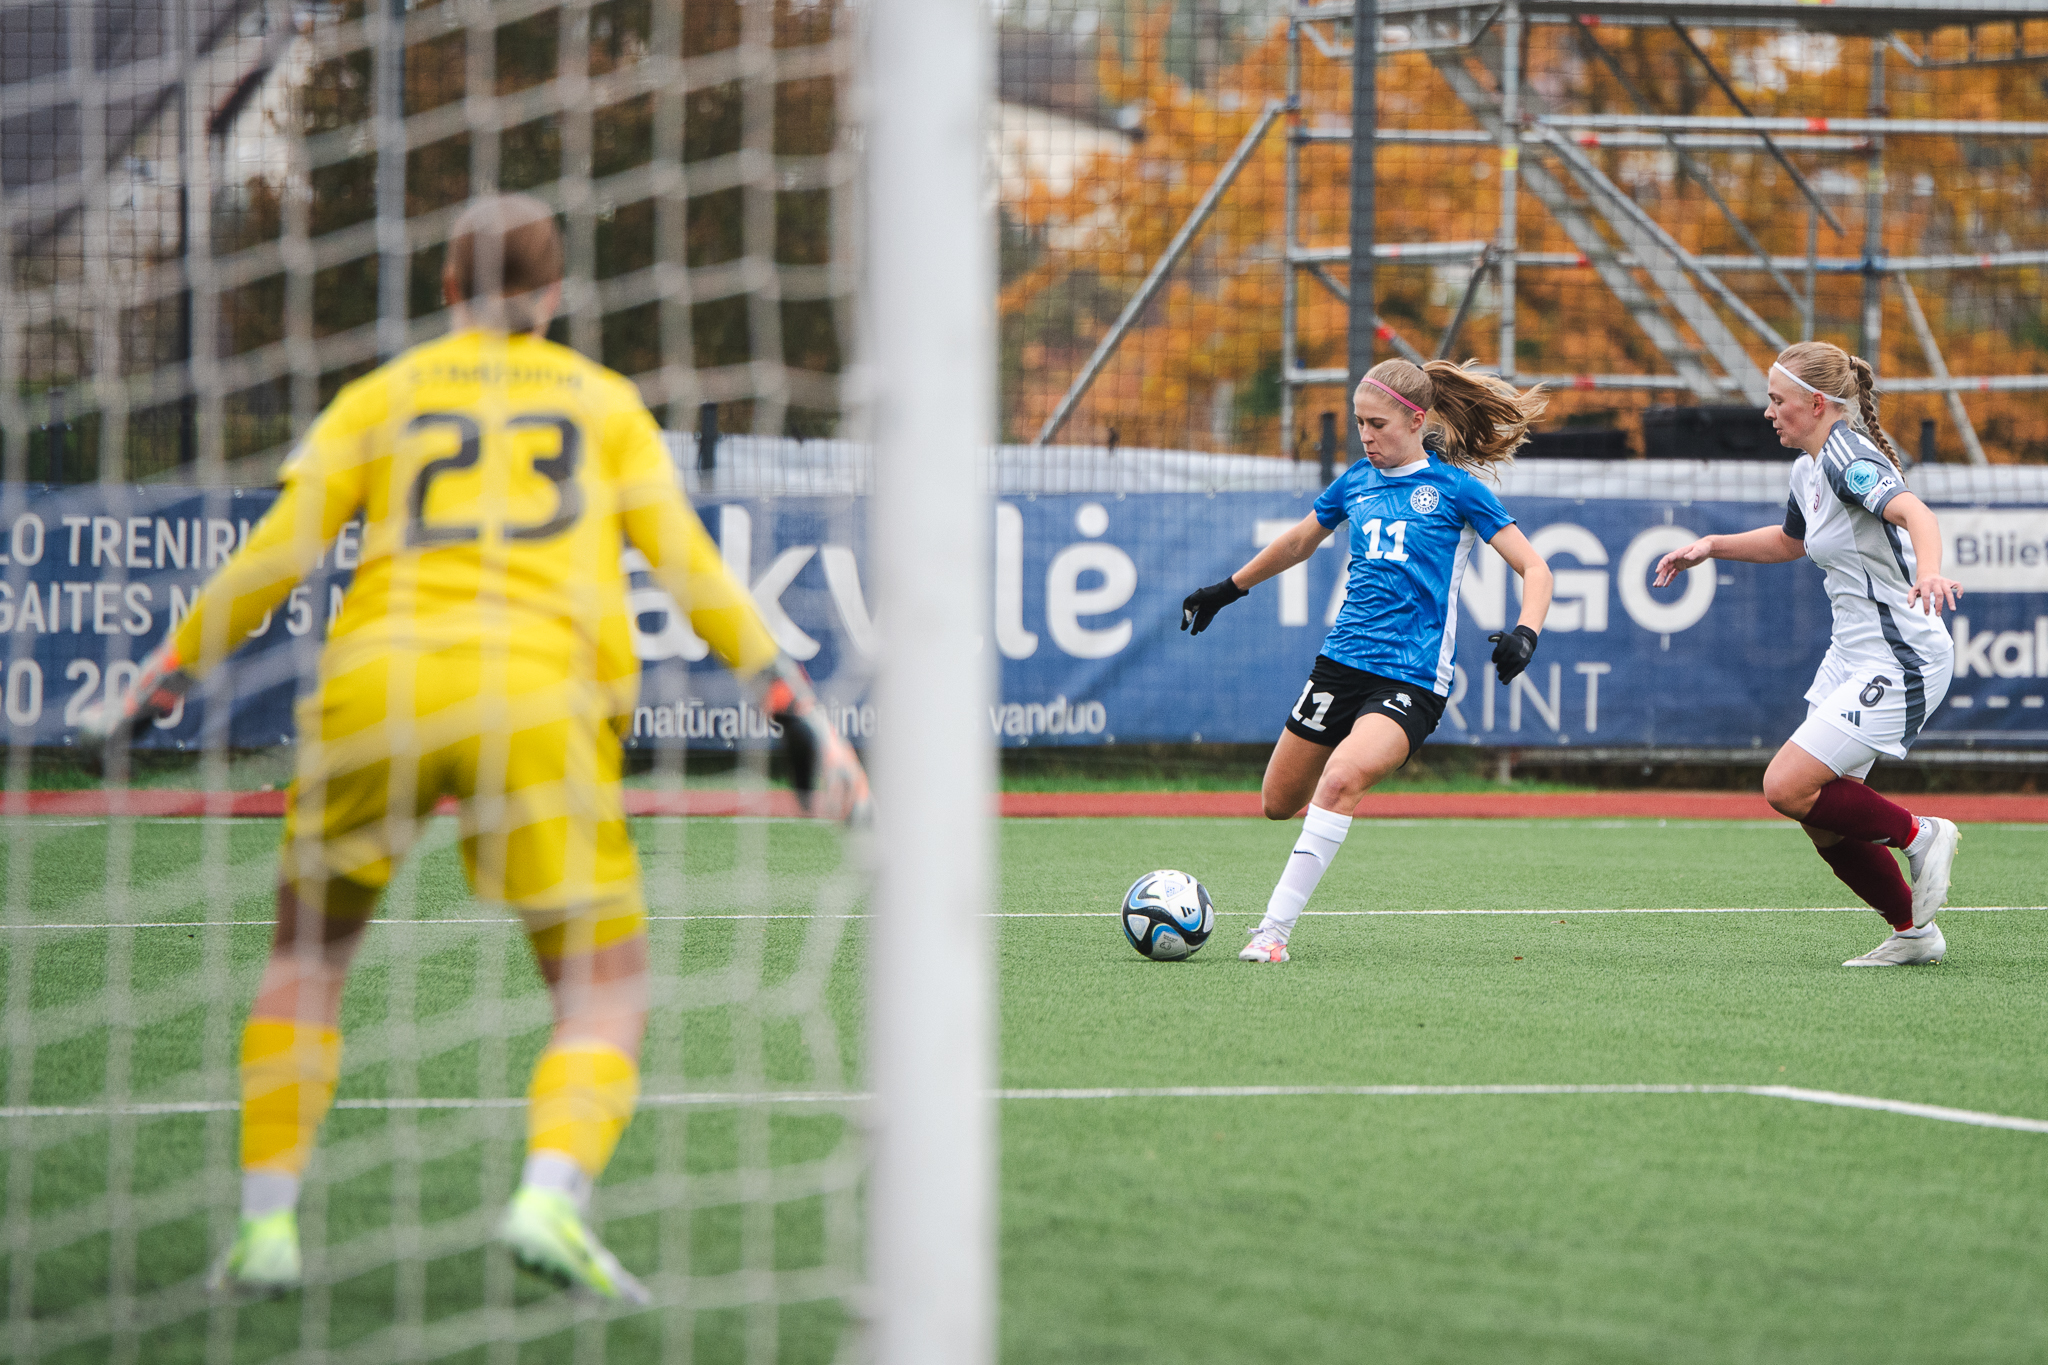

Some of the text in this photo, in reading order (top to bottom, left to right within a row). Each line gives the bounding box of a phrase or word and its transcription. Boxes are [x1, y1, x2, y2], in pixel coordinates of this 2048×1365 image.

[405, 411, 585, 546] 23
[0, 513, 45, 566] O
[1361, 518, 1410, 562] 11
[1254, 520, 1717, 634] TNGO
[284, 585, 312, 636] 5
[988, 694, 1107, 736] vanduo
[1292, 680, 1335, 732] 11
[1859, 675, 1892, 708] 6
